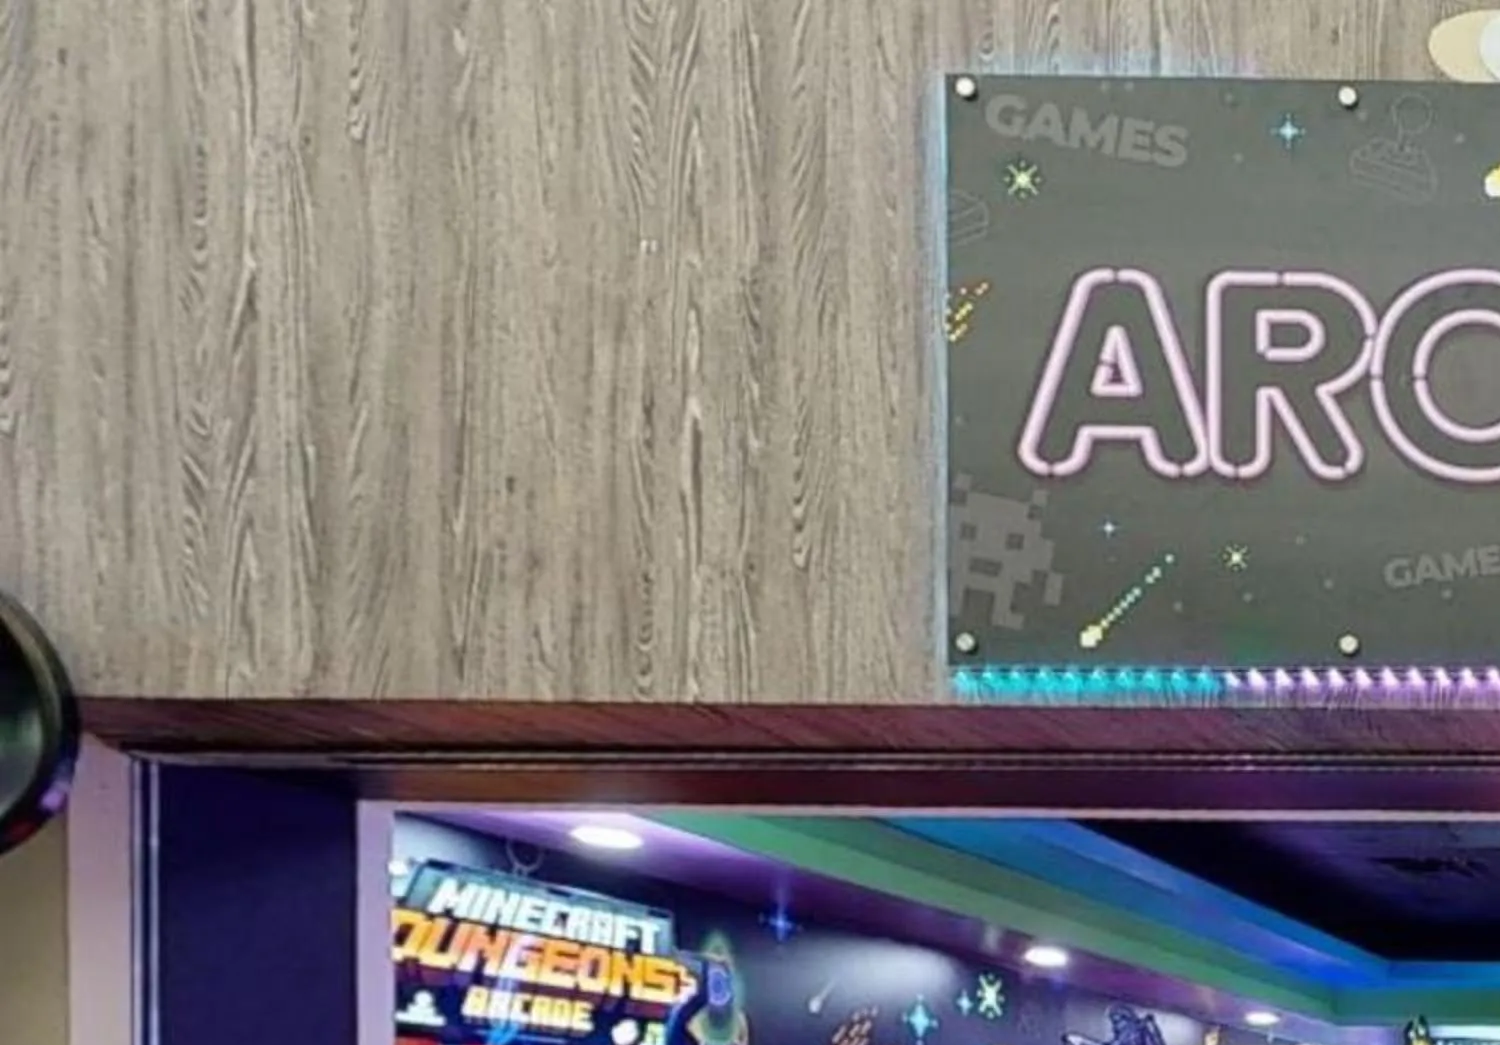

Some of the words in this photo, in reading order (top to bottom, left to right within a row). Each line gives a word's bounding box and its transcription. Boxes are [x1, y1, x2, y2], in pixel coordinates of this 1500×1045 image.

[985, 93, 1189, 167] GAMES
[427, 878, 662, 955] MINECRAFT
[391, 908, 692, 1004] DUNGEONS
[462, 985, 595, 1031] ARCADE
